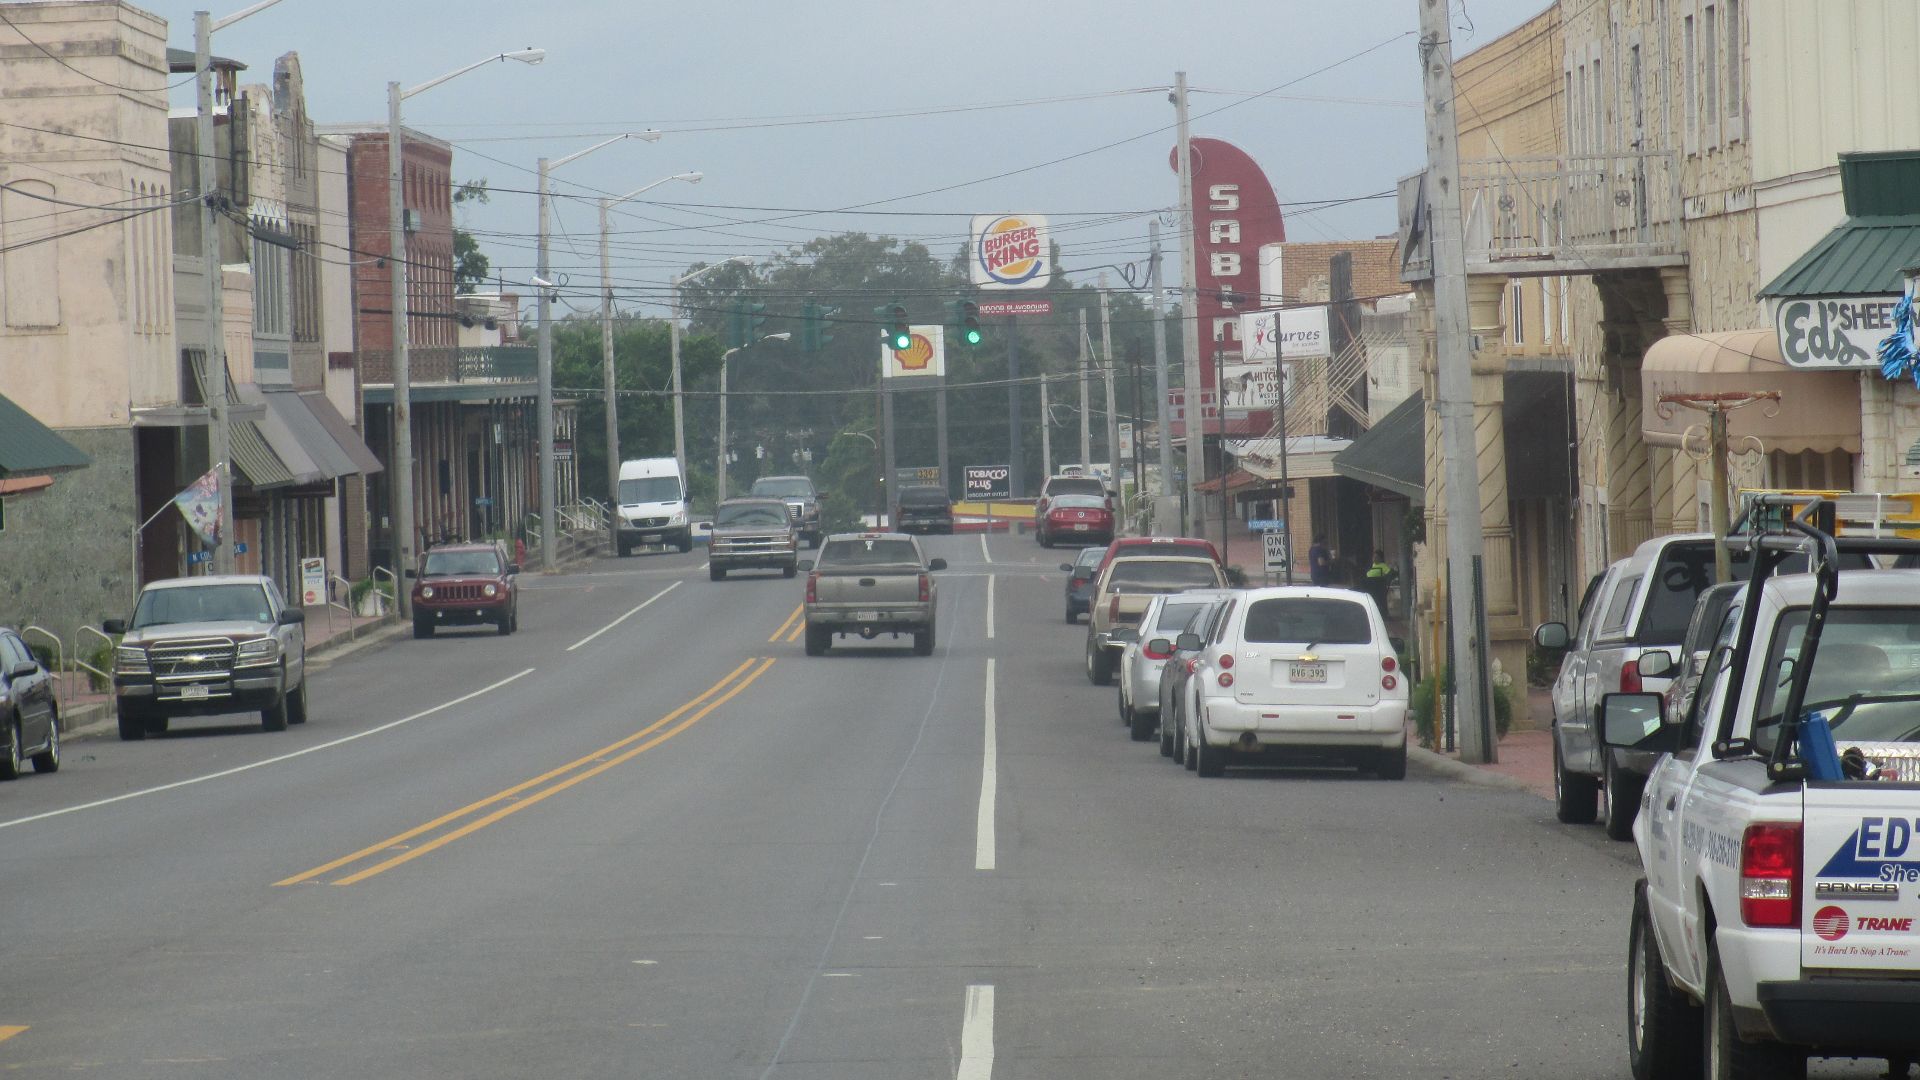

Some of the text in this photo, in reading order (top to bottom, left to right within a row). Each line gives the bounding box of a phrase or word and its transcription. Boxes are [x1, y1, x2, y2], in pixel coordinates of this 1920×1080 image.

[985, 227, 1037, 254] BURGER
[987, 239, 1040, 272] KING
[1266, 328, 1320, 343] Curves
[1257, 382, 1282, 393] POS
[969, 469, 1008, 479] TOBACCO
[969, 480, 991, 490] PLUS
[1268, 547, 1286, 557] WA
[1817, 882, 1899, 893] RANGER
[1857, 917, 1913, 932] TRANE
[1814, 946, 1826, 954] It's
[1827, 946, 1848, 955] Hard
[1849, 946, 1858, 955] To
[1860, 946, 1877, 957] Stop
